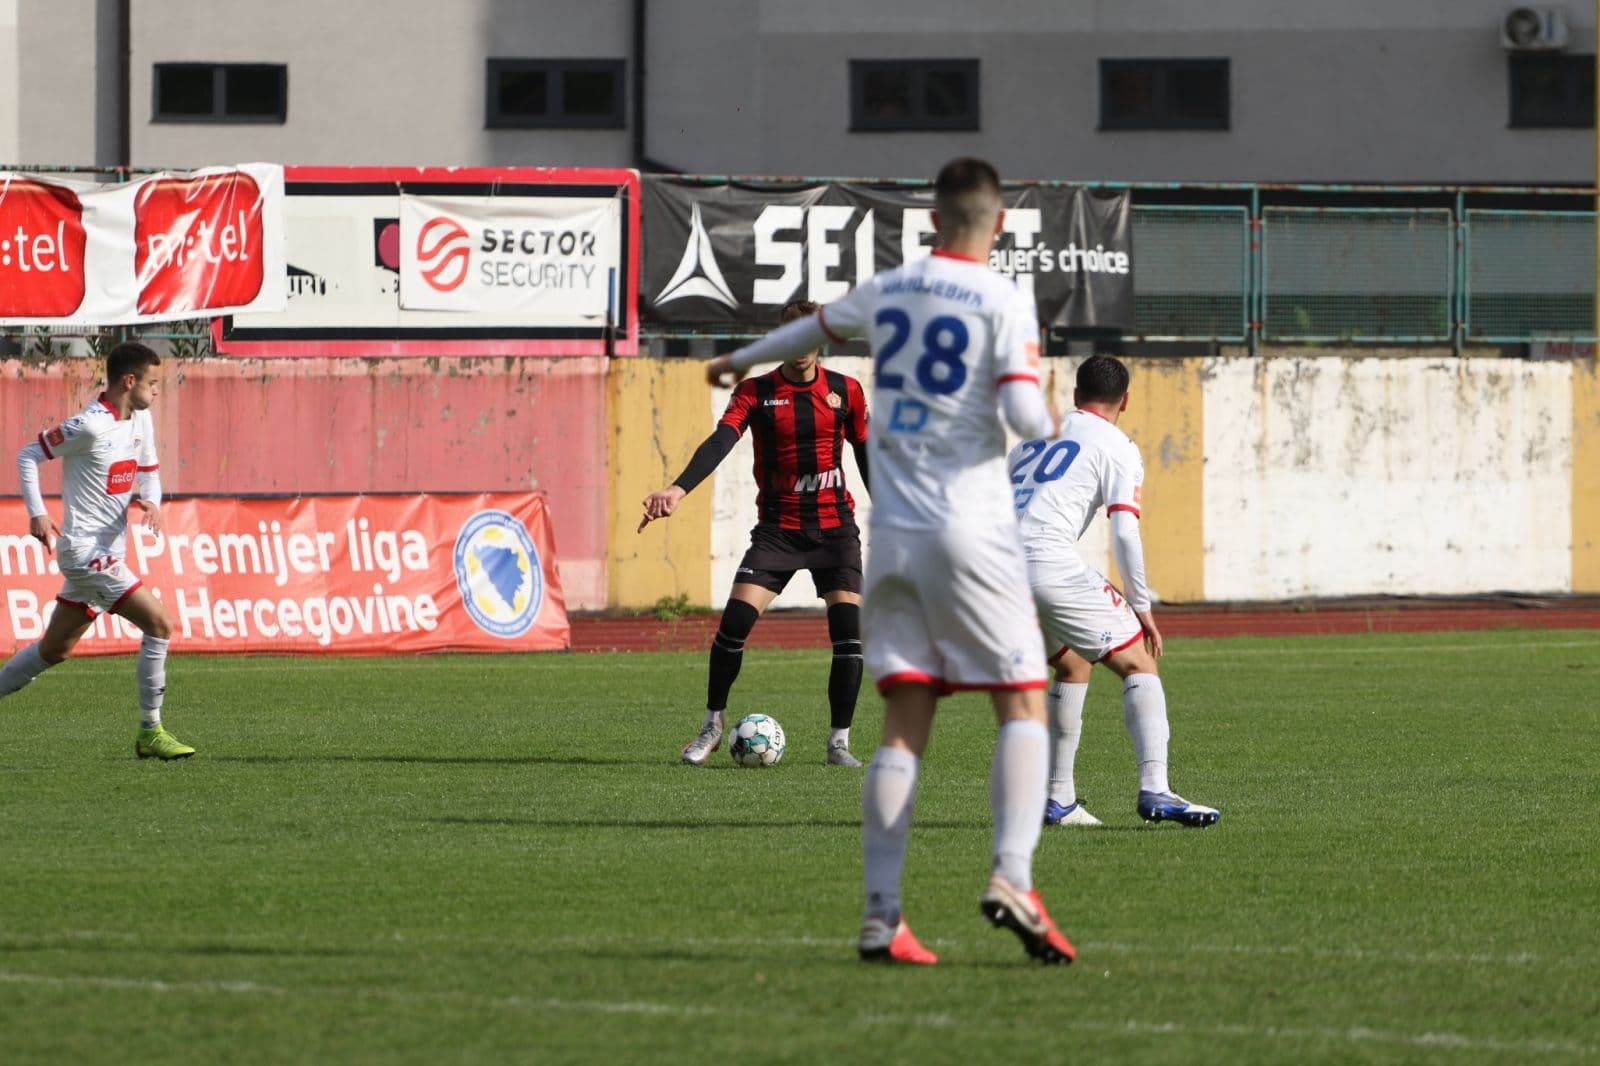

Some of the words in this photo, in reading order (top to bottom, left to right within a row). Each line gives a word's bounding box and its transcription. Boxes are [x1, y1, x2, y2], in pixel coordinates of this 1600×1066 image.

[481, 228, 596, 256] SECTOR
[988, 241, 1054, 278] ayer's
[1058, 242, 1130, 275] choice
[480, 260, 596, 289] SECURITY
[875, 307, 969, 396] 28
[1010, 439, 1081, 484] 20
[130, 521, 335, 587] Premijer
[346, 517, 429, 584] liga
[175, 583, 440, 645] Hercegovine
